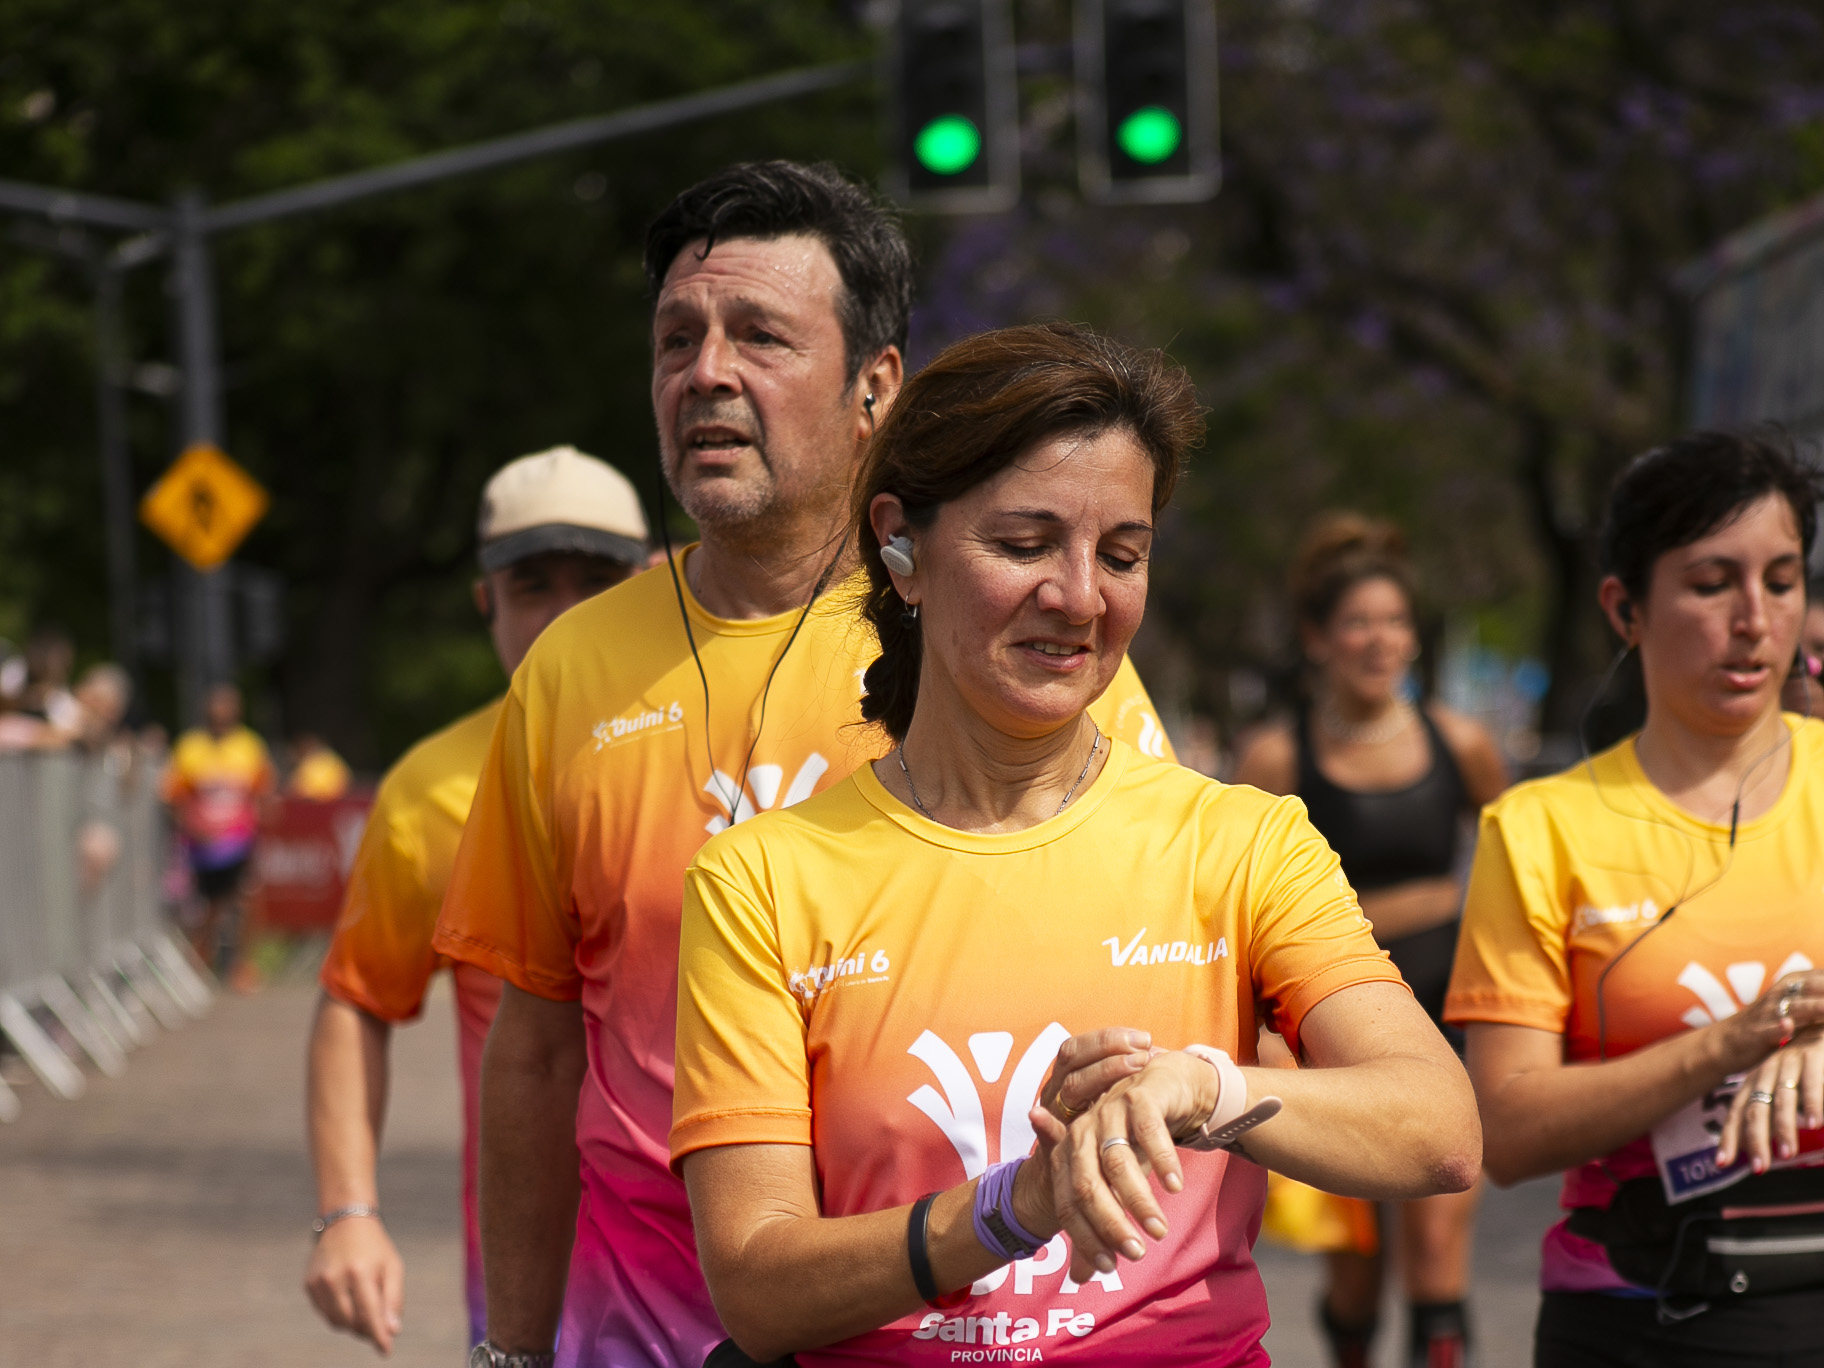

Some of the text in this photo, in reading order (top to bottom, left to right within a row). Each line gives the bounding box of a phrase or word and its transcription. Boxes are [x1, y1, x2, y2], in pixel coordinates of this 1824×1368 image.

[668, 701, 683, 722] 6
[1102, 927, 1229, 967] VANDALIA
[870, 949, 890, 973] 6
[912, 1308, 1096, 1345] Santa Fe
[951, 1347, 1043, 1363] PROVINCIA
